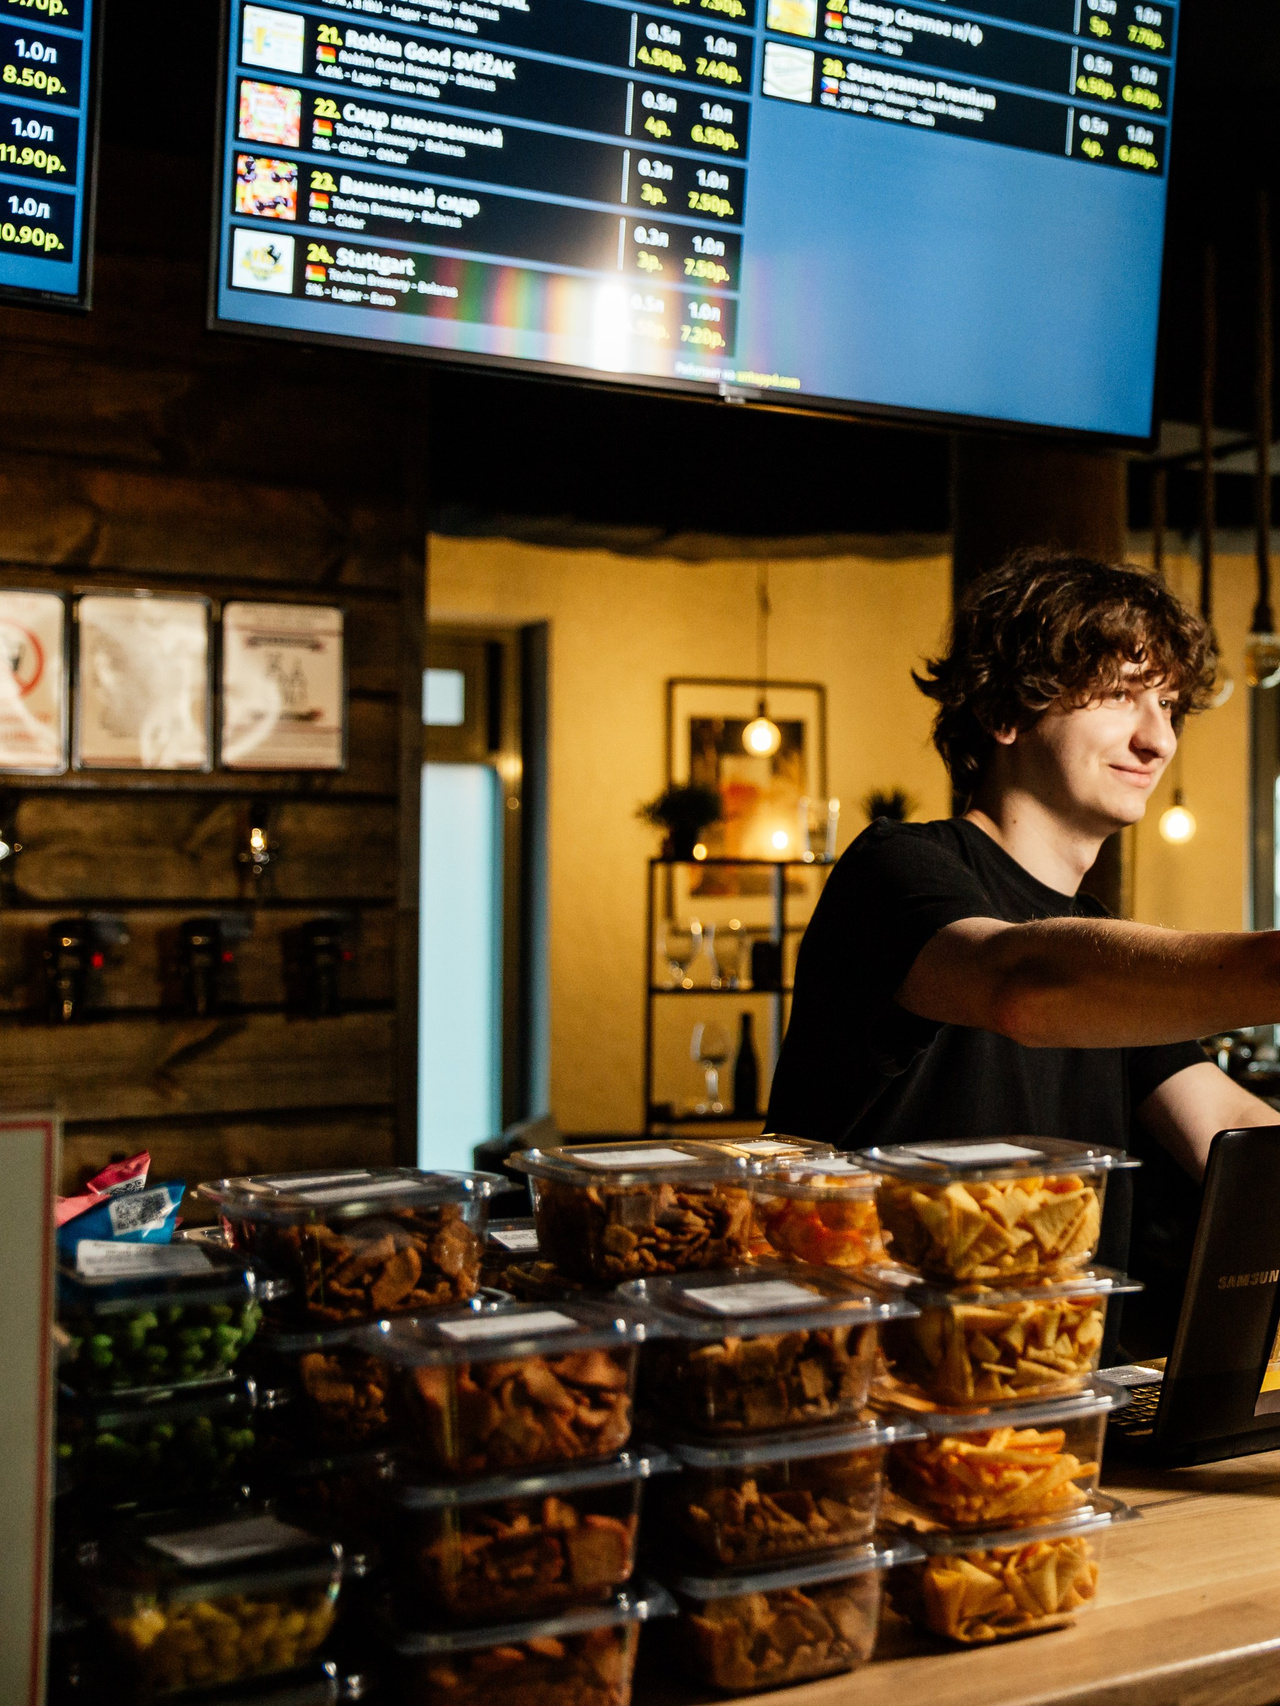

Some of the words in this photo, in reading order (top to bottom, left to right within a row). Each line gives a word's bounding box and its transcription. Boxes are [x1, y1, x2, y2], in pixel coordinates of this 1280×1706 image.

[1134, 4, 1163, 27] 1.0л
[14, 38, 57, 64] 1.0л
[317, 23, 343, 46] 21.
[345, 29, 402, 58] Robim
[404, 41, 452, 68] Good
[645, 22, 682, 46] 0.5л
[703, 34, 738, 58] 1.0л
[2, 64, 67, 95] 8.50р.
[637, 45, 687, 73] 4.50р.
[695, 57, 742, 85] 7.40р.
[1083, 53, 1114, 76] 0.5л
[1129, 64, 1159, 87] 1.0л
[641, 90, 678, 114] 0.5л
[700, 101, 734, 125] 1.0л
[936, 81, 997, 111] Premium
[11, 117, 55, 143] 1.0л
[313, 97, 342, 120] 22.
[342, 103, 390, 131] Сидр
[1078, 114, 1110, 137] 0.5л
[1126, 124, 1155, 146] 1.0л
[644, 115, 672, 139] 4р.
[690, 124, 739, 151] 6.50р.
[0, 143, 67, 174] 11.90р.
[637, 157, 674, 181] 0.3л
[695, 168, 730, 191] 1.0л
[8, 195, 51, 220] 1.0л
[309, 170, 338, 193] 23.
[339, 174, 436, 209] Вишневый
[436, 194, 481, 219] сидр
[640, 182, 668, 206] 3р.
[687, 190, 735, 218] 7.50р.
[0, 222, 65, 252] 0.90р.
[633, 225, 670, 248] 0.3л
[692, 235, 726, 257] 1.0л
[306, 243, 335, 265] 24.
[336, 246, 417, 276] Stuttgart
[683, 257, 731, 284] 7.50р.
[688, 301, 722, 323] 1.0л
